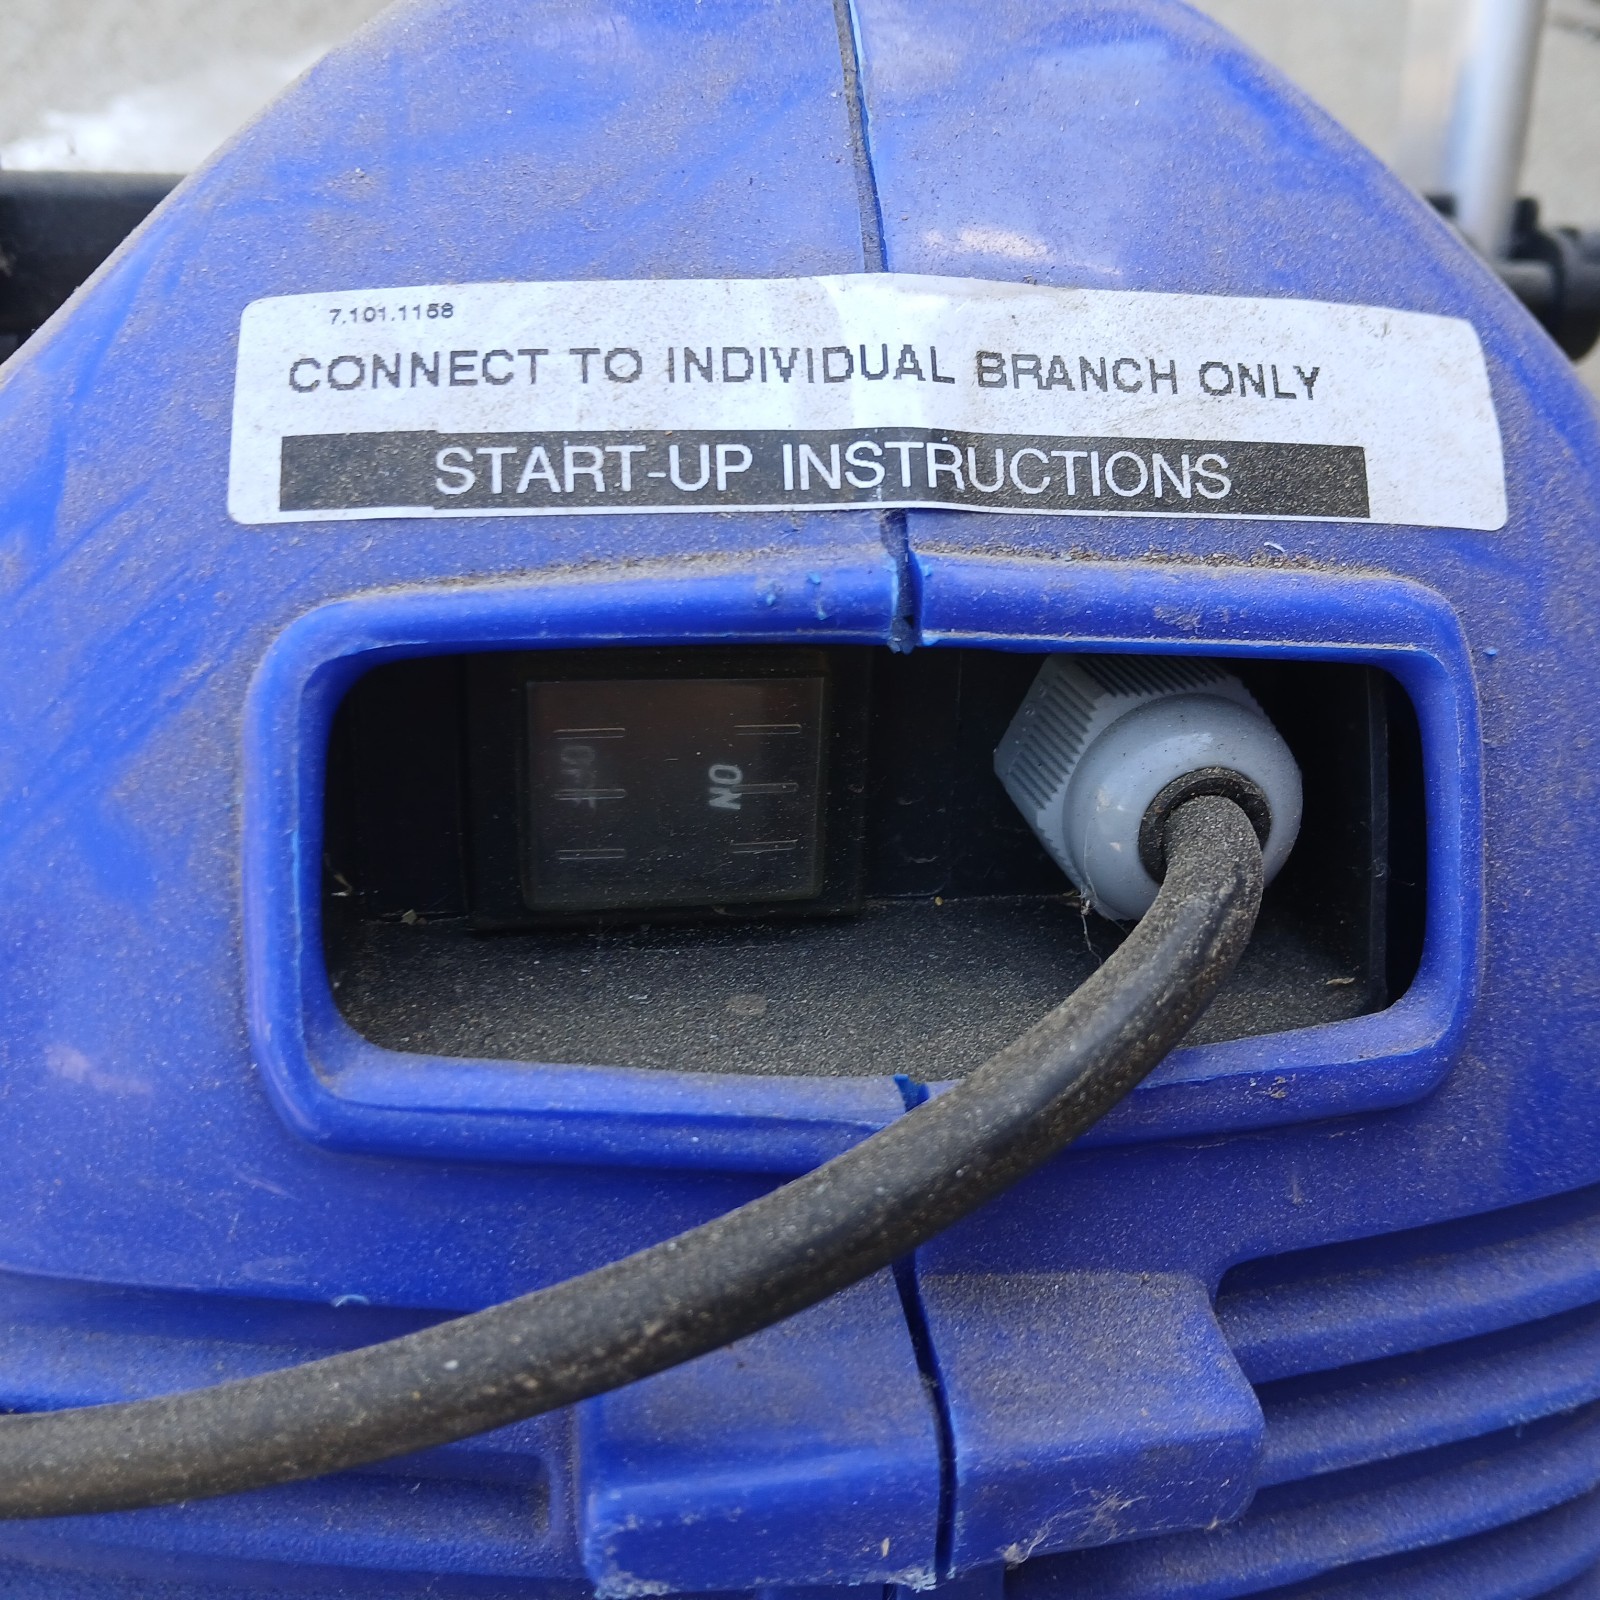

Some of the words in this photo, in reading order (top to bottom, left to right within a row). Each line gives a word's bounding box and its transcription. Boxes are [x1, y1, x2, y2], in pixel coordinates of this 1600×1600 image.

[289, 348, 549, 392] CONNECT
[569, 346, 643, 384] TO
[668, 343, 956, 384] INDIVIDUAL
[976, 350, 1178, 395] BRANCH
[1199, 360, 1321, 401] ONLY
[435, 443, 754, 496] START-UP
[783, 440, 1233, 501] INSTRUCTIONS
[708, 764, 744, 810] ON
